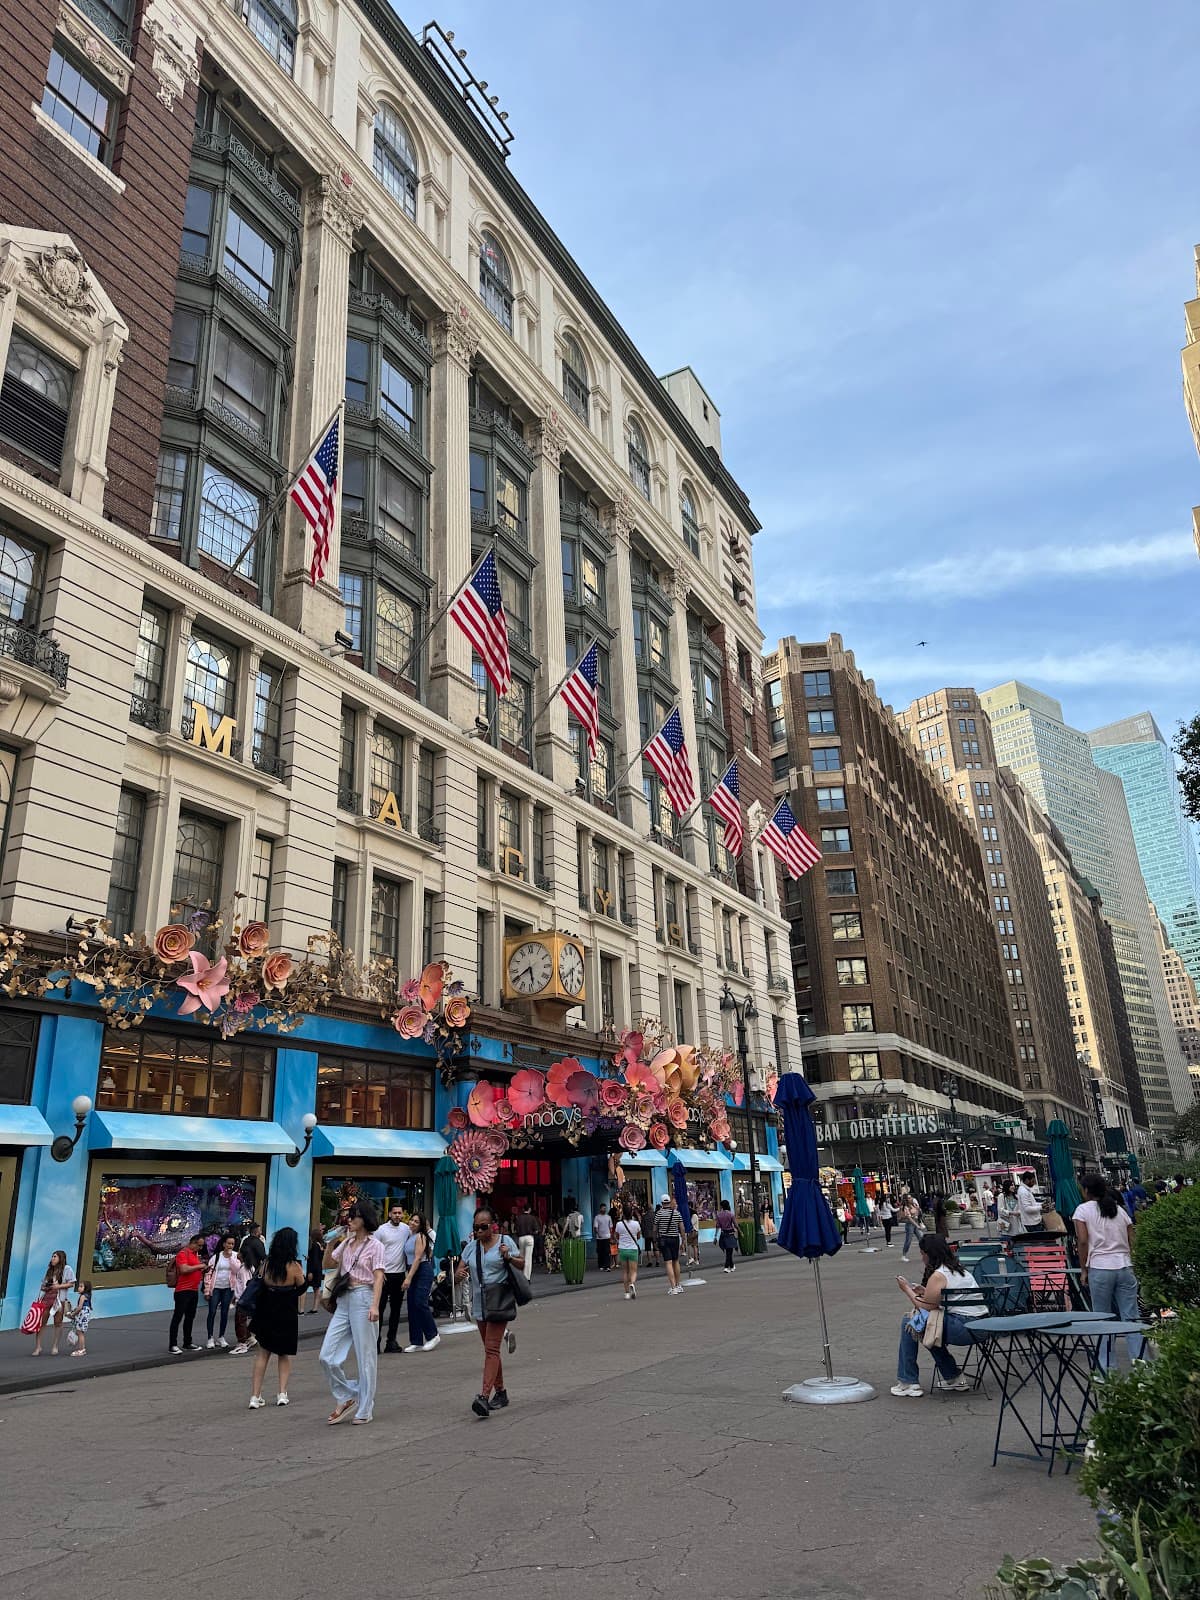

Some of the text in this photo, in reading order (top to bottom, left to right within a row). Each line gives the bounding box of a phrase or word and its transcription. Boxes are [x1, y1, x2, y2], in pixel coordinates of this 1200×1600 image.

[191, 701, 237, 759] M
[376, 791, 402, 831] A
[815, 1122, 841, 1143] BAN
[850, 1113, 938, 1140] OUTFITTERS
